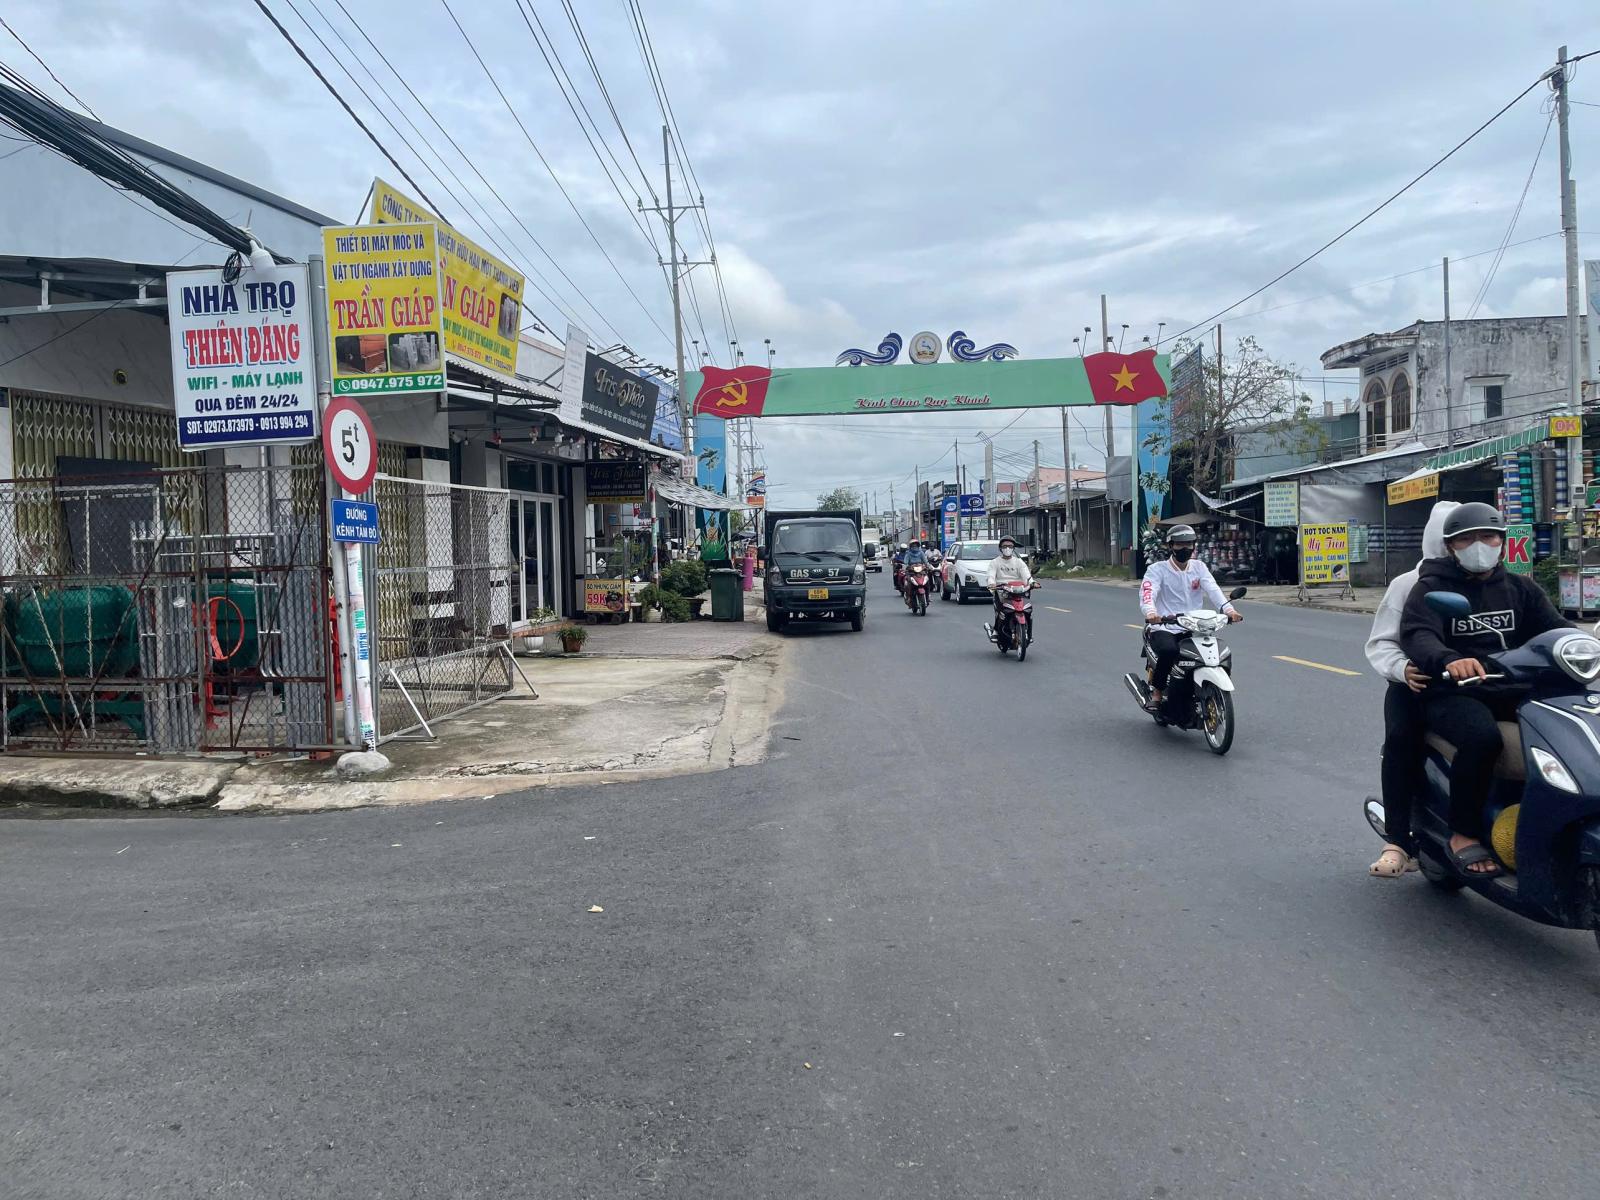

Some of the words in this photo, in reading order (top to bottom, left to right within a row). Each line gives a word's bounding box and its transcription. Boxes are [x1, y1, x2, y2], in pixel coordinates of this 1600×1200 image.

[335, 231, 359, 253] THIẾT
[361, 237, 371, 256] BỊ
[372, 233, 390, 251] MÁY
[332, 261, 347, 284] VẬT
[349, 263, 361, 280] TƯ
[361, 260, 390, 279] NGÀNH
[392, 258, 408, 278] XÂY
[410, 260, 432, 280] DỰNG
[243, 280, 296, 317] TRỌ
[334, 283, 385, 330] TRẦN
[391, 287, 435, 328] GIÁP
[460, 286, 496, 328] GIÁP
[182, 319, 244, 369] THIÊN
[187, 376, 218, 391] WIFI
[231, 372, 262, 389] MÁY
[266, 371, 303, 389] LẠNH
[351, 377, 414, 390] 0947.975
[417, 375, 443, 386] 972
[195, 398, 222, 413] QUA
[225, 394, 256, 410] ĐÊM
[260, 394, 299, 409] 24/24
[204, 418, 255, 434] 02973.873979
[260, 416, 278, 431] 0913
[279, 416, 293, 430] 994
[294, 414, 309, 429] 294
[1554, 418, 1577, 433] OK
[336, 522, 355, 537] KÊNH
[1332, 526, 1346, 534] NAM
[1501, 536, 1530, 563] K
[790, 569, 809, 578] GAS
[828, 568, 840, 577] 57
